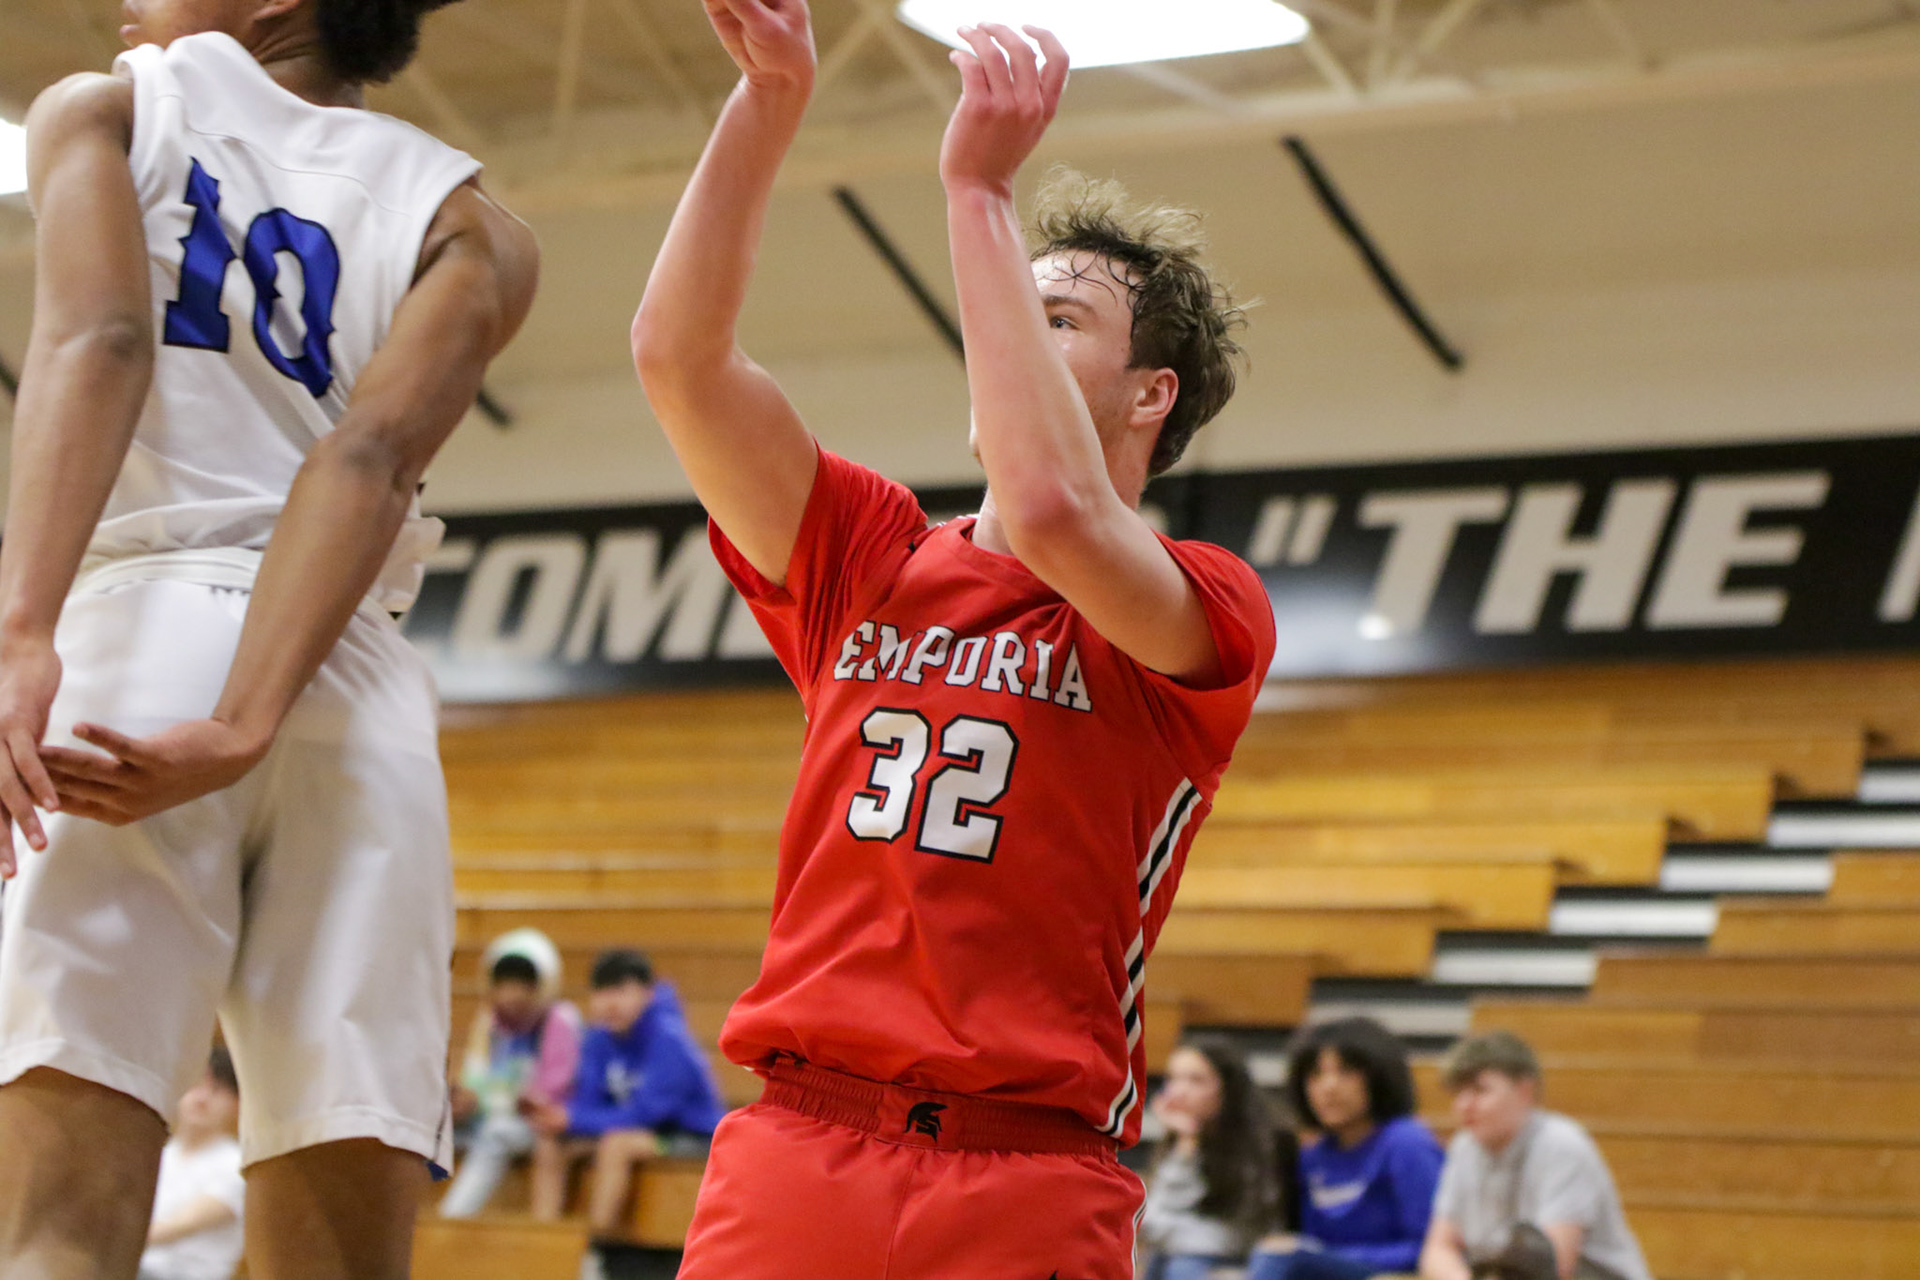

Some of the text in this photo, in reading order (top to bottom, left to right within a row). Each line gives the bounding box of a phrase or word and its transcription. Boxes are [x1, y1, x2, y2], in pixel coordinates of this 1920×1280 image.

[162, 156, 341, 399] 10
[834, 620, 1093, 712] EMPORIA
[846, 706, 1020, 864] 32
